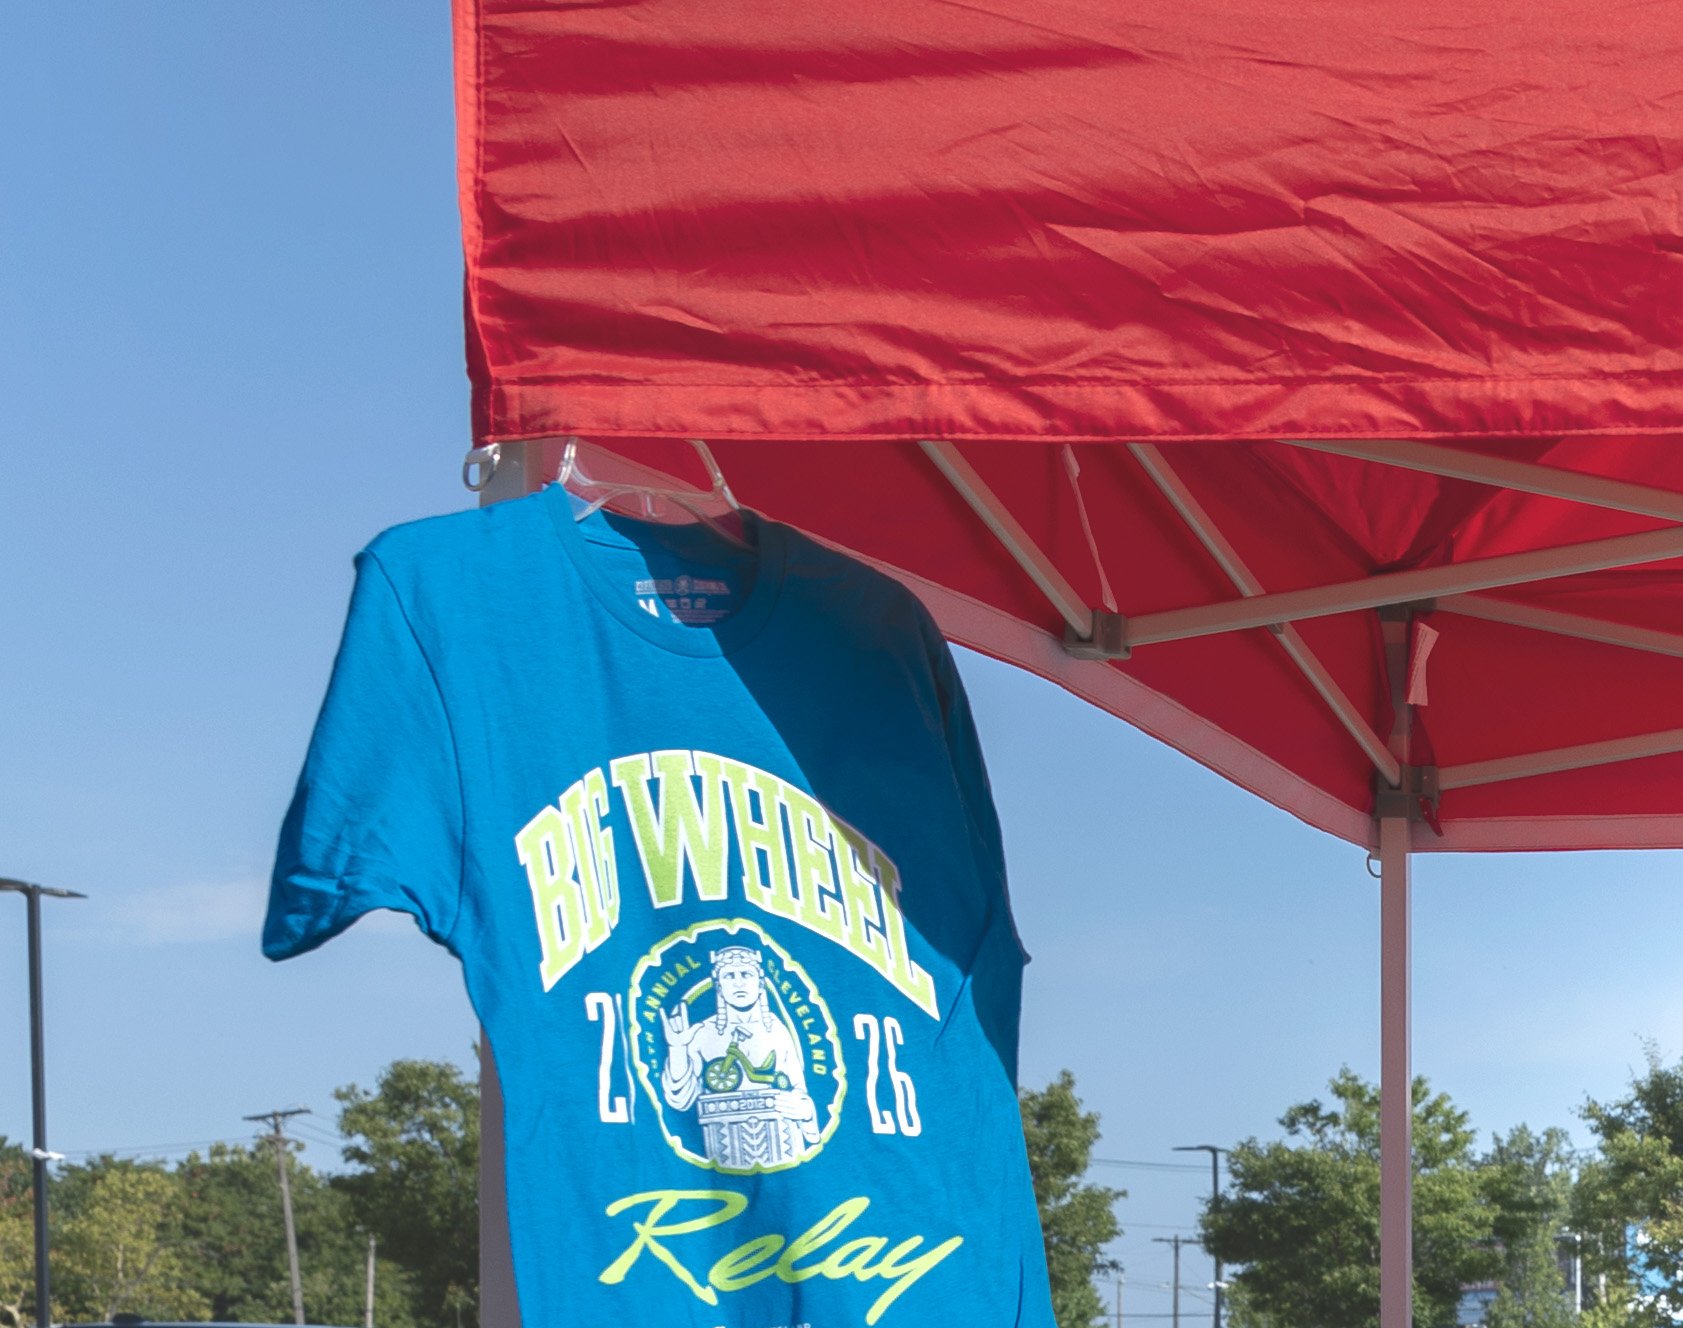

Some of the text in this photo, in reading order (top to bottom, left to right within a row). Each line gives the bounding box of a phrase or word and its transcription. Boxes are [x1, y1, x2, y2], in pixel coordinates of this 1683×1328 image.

[514, 749, 941, 1020] BIG WHEEL
[643, 955, 701, 1023] ANNUAL
[767, 960, 827, 1077] CLEVELAND
[585, 991, 635, 1126] 2
[853, 1013, 922, 1137] 26
[599, 1188, 963, 1325] Relay
